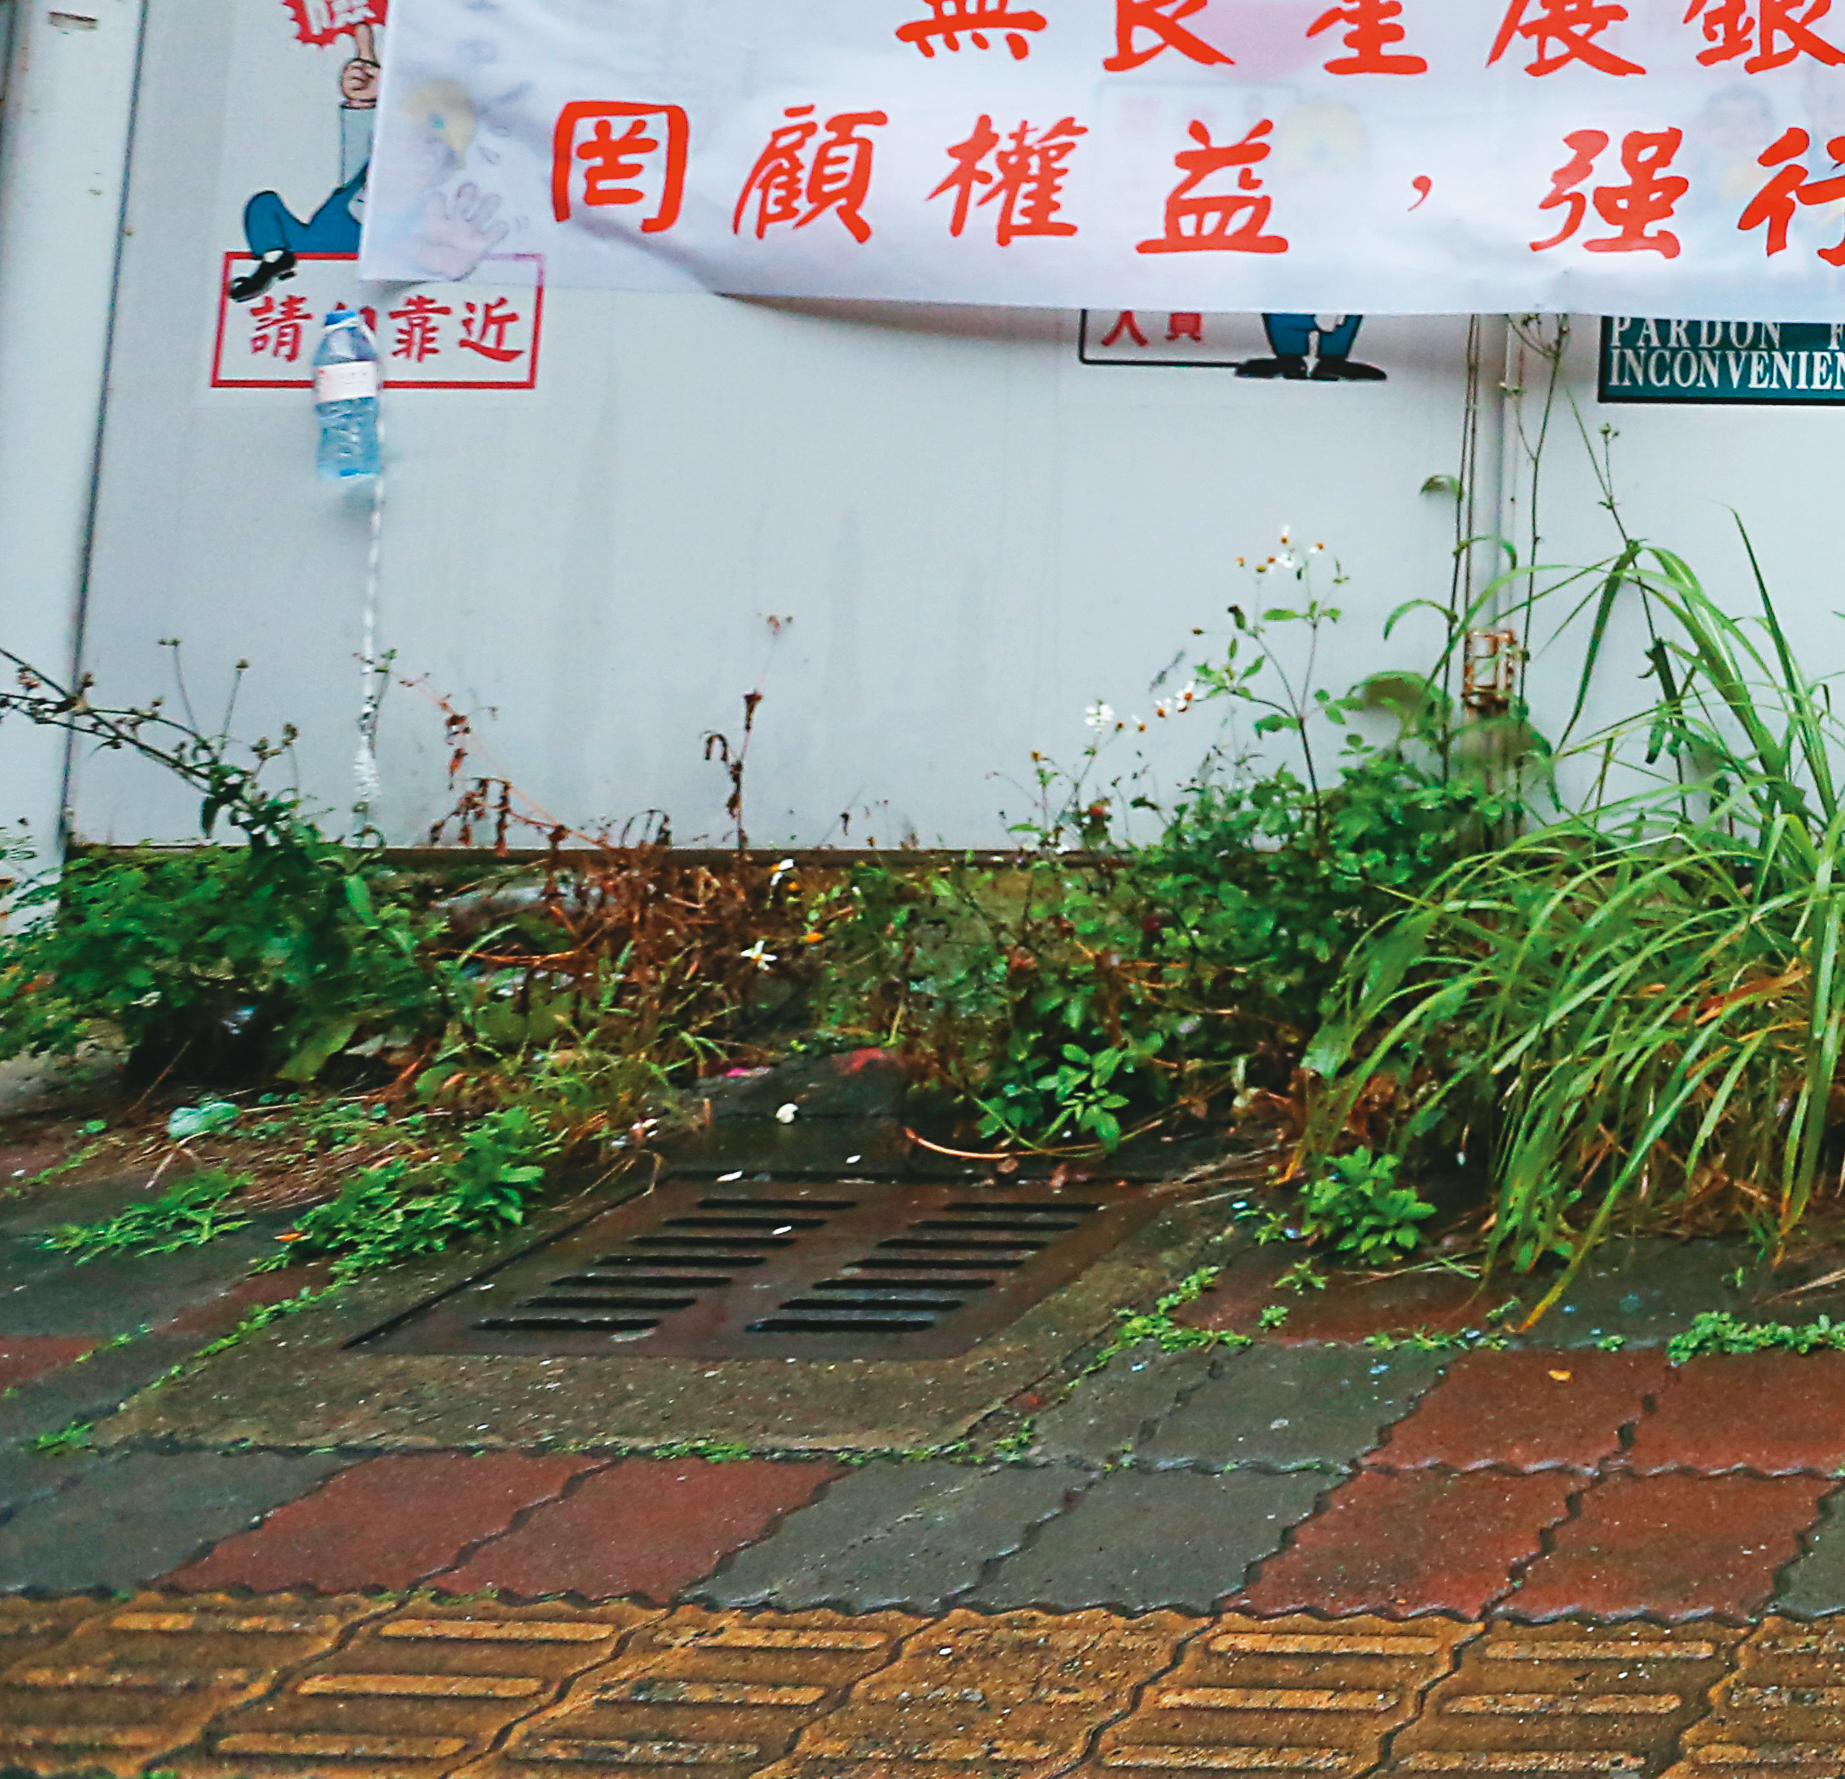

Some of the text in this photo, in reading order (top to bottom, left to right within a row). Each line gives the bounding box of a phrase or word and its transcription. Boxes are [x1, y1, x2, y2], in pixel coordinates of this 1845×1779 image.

[249, 294, 525, 363] 請靠近
[1610, 317, 1781, 350] PARDON
